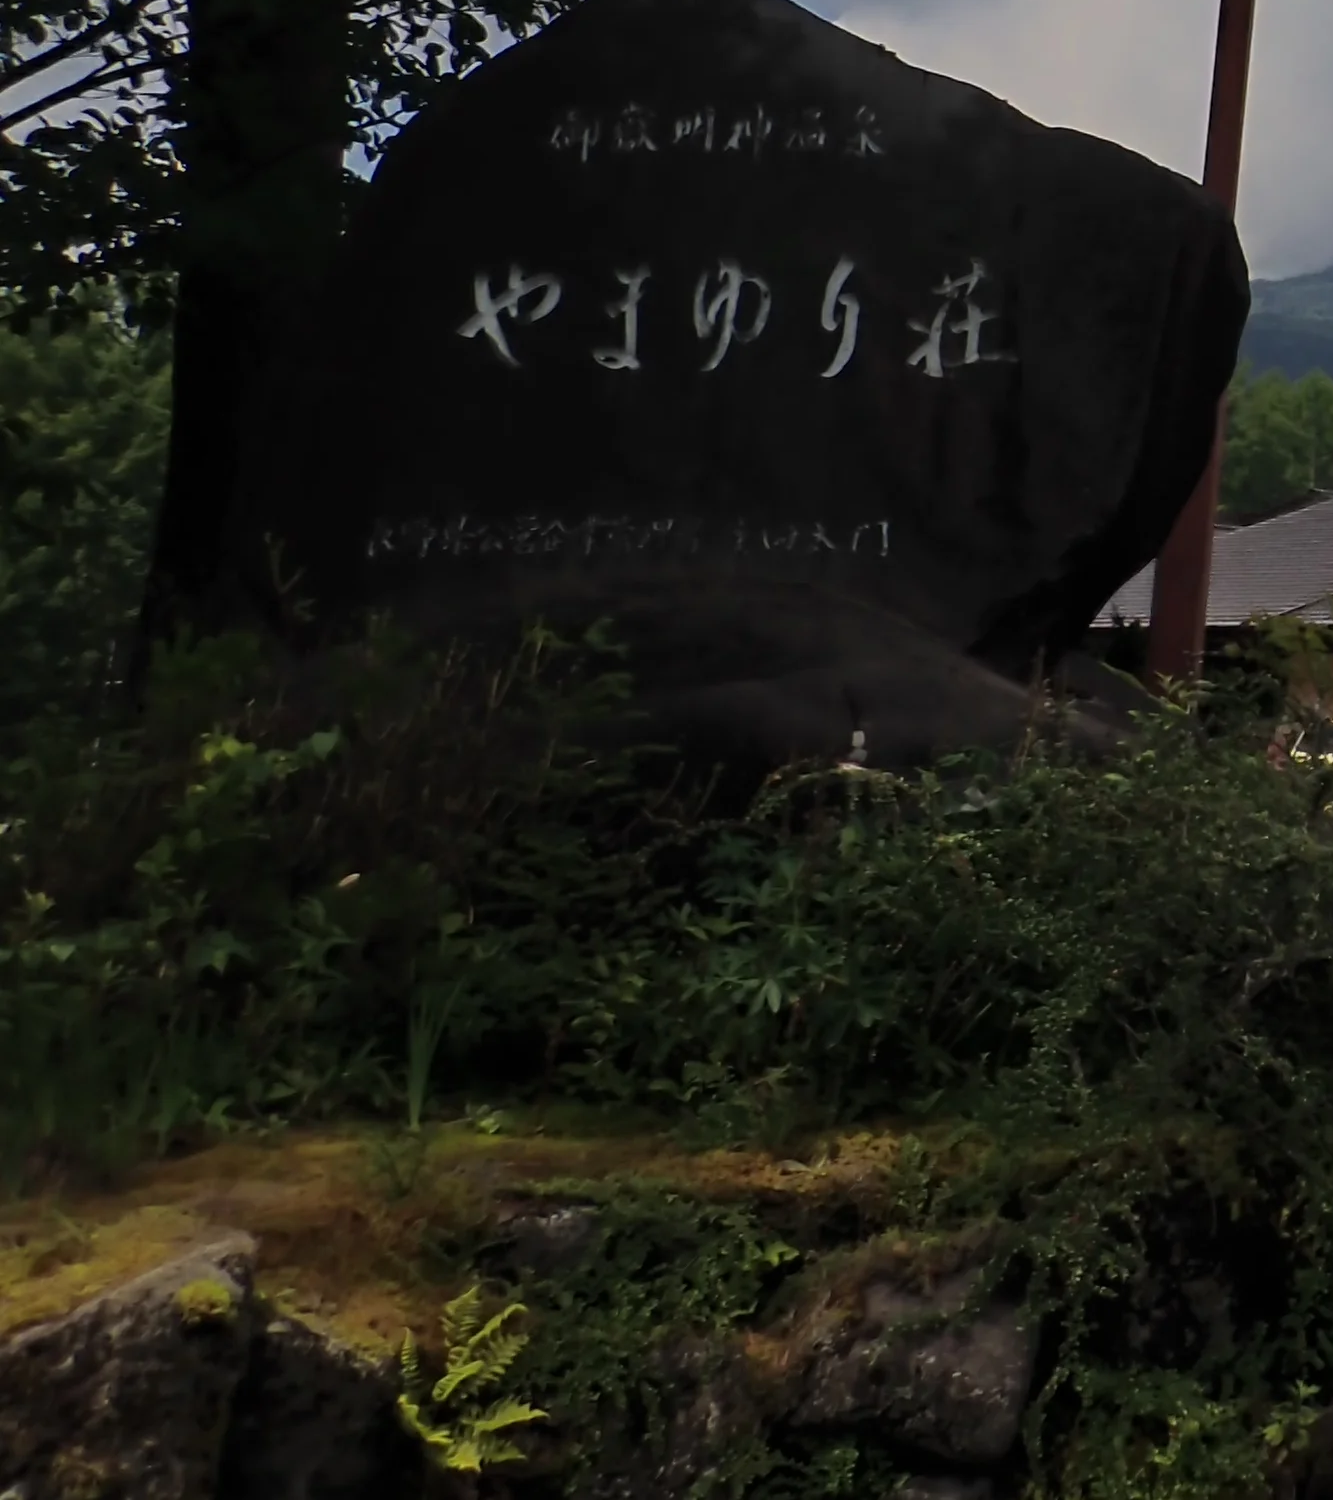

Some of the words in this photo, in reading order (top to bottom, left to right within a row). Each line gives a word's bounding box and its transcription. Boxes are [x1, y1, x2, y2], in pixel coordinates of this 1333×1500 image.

[456, 252, 1019, 379] やまゆり荘
